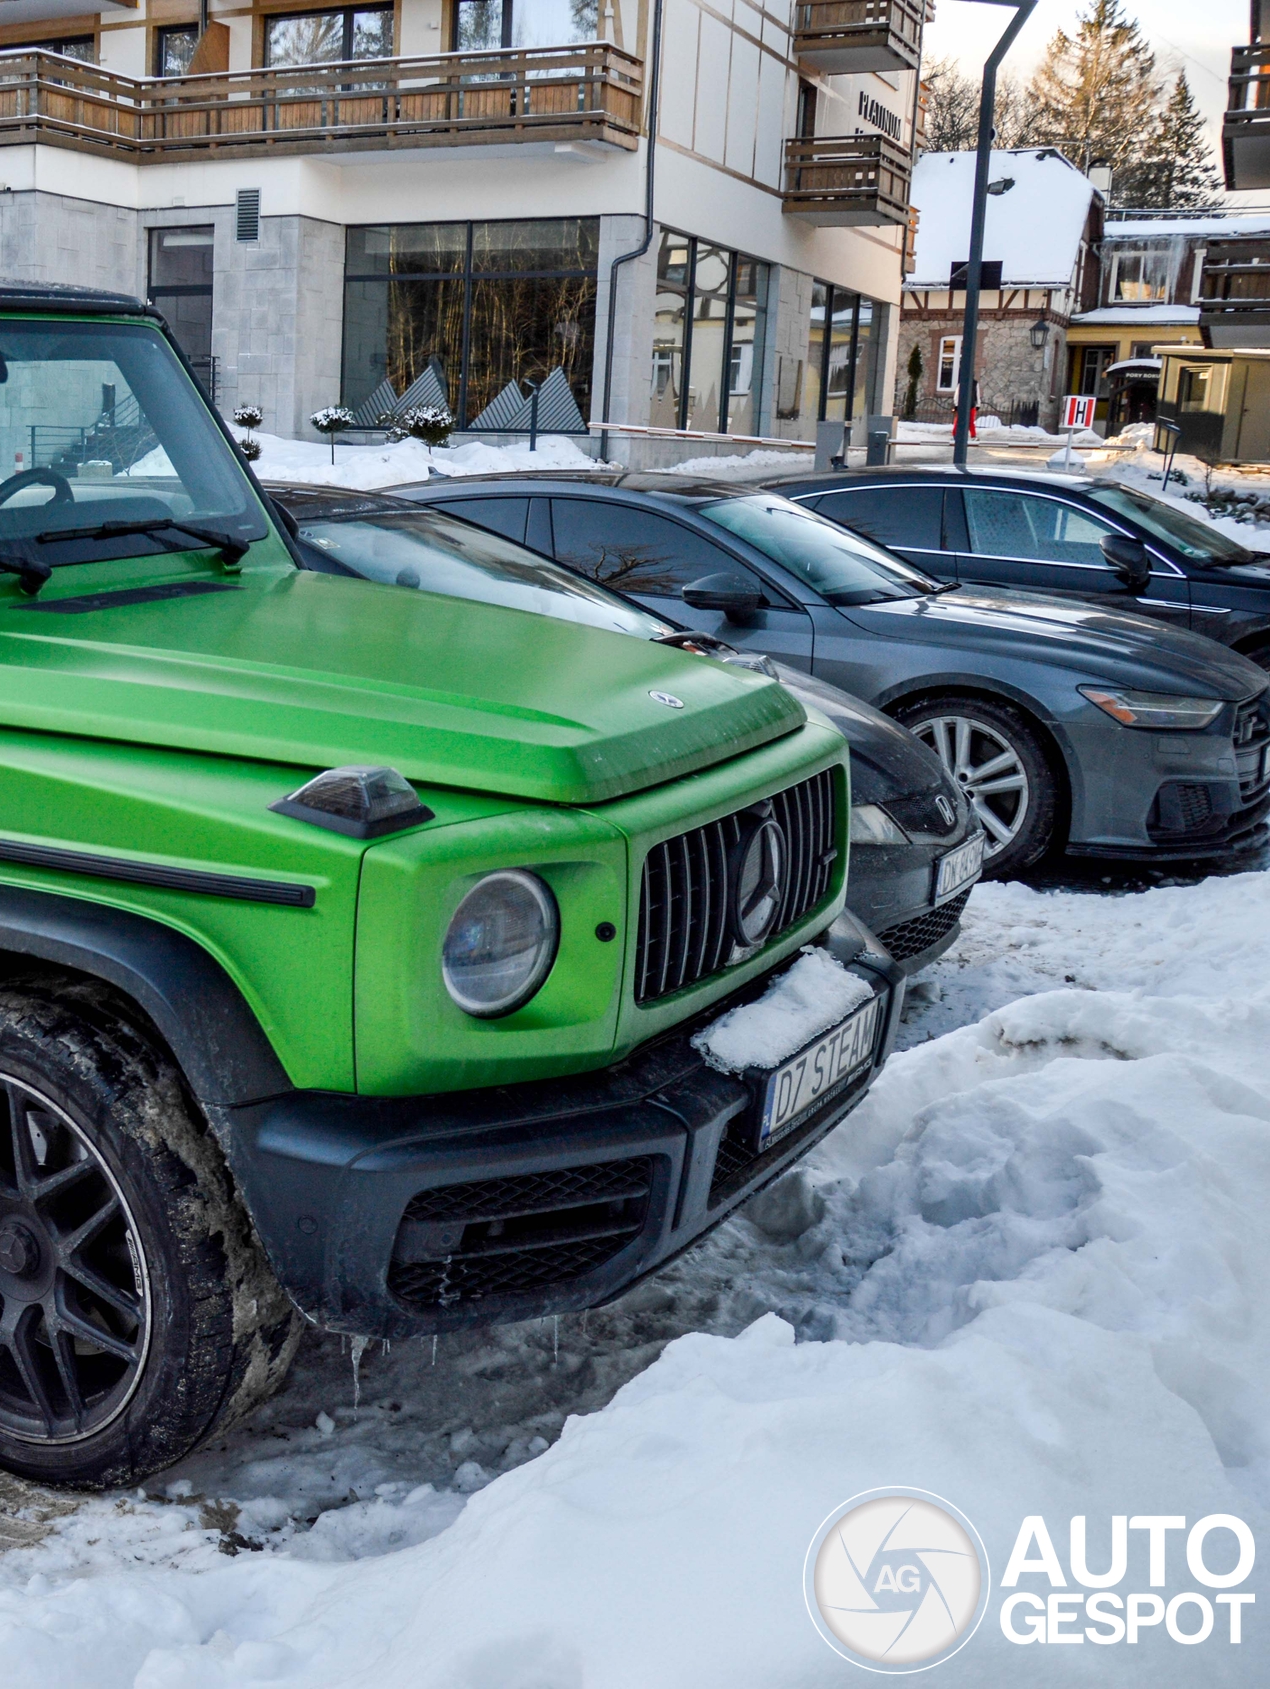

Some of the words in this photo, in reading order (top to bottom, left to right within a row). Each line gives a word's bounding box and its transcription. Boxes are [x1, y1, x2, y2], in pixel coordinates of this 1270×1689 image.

[858, 90, 901, 142] PLATINUM
[1075, 400, 1087, 424] H
[775, 1056, 808, 1126] D7
[811, 1004, 876, 1096] STEAM
